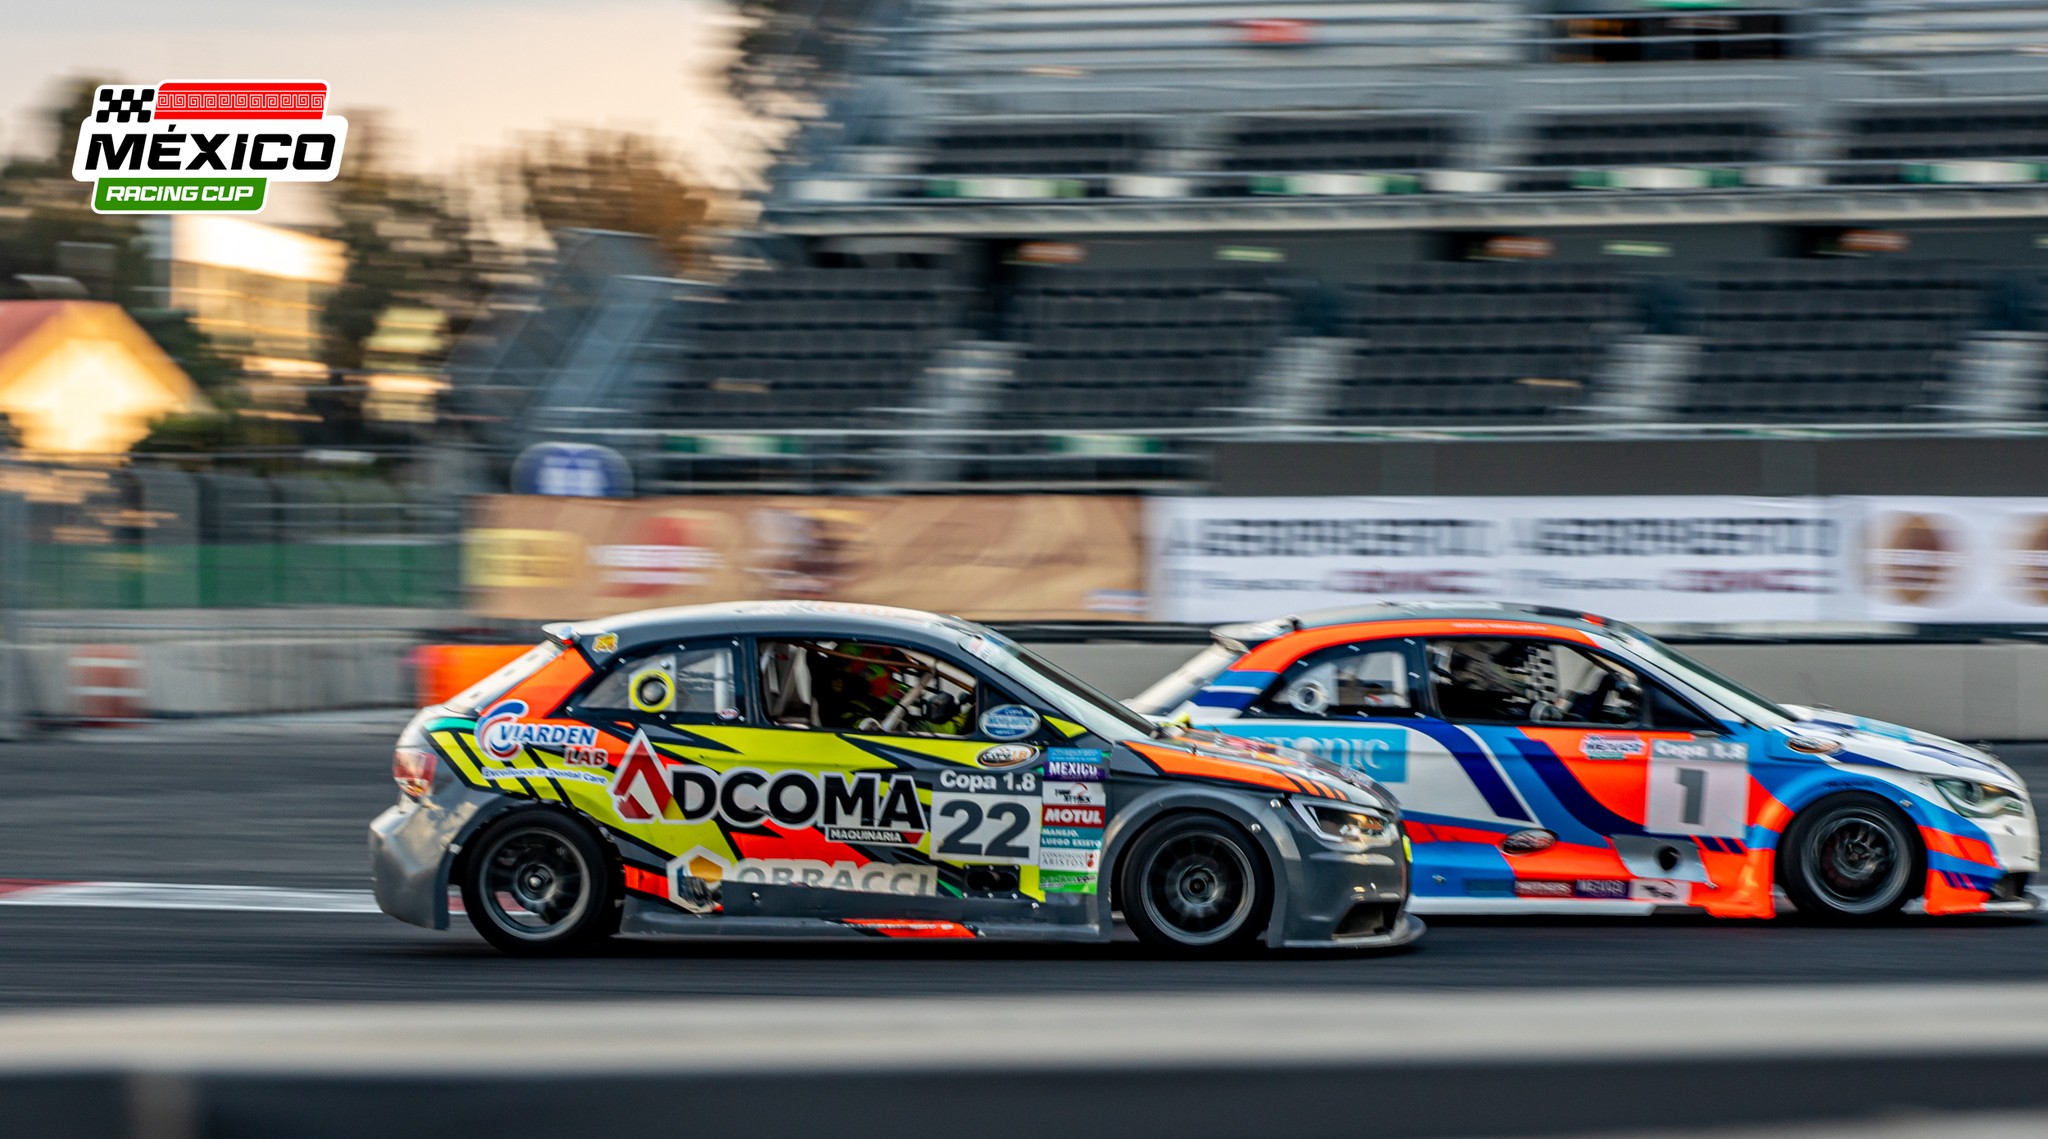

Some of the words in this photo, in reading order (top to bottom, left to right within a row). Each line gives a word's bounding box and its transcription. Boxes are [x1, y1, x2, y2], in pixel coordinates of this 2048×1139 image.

[500, 724, 596, 745] VIARDEN
[566, 749, 607, 766] LAB
[583, 773, 606, 784] Care
[612, 738, 924, 828] ADCOMA
[940, 770, 997, 792] Copa
[1003, 772, 1036, 792] 1.8
[1677, 767, 1705, 825] 1
[1044, 808, 1102, 824] MOTUL
[830, 829, 903, 843] MAQUINARIA
[937, 800, 1030, 858] 22
[1041, 838, 1070, 846] LUEGO
[1072, 839, 1102, 848] EXISTO
